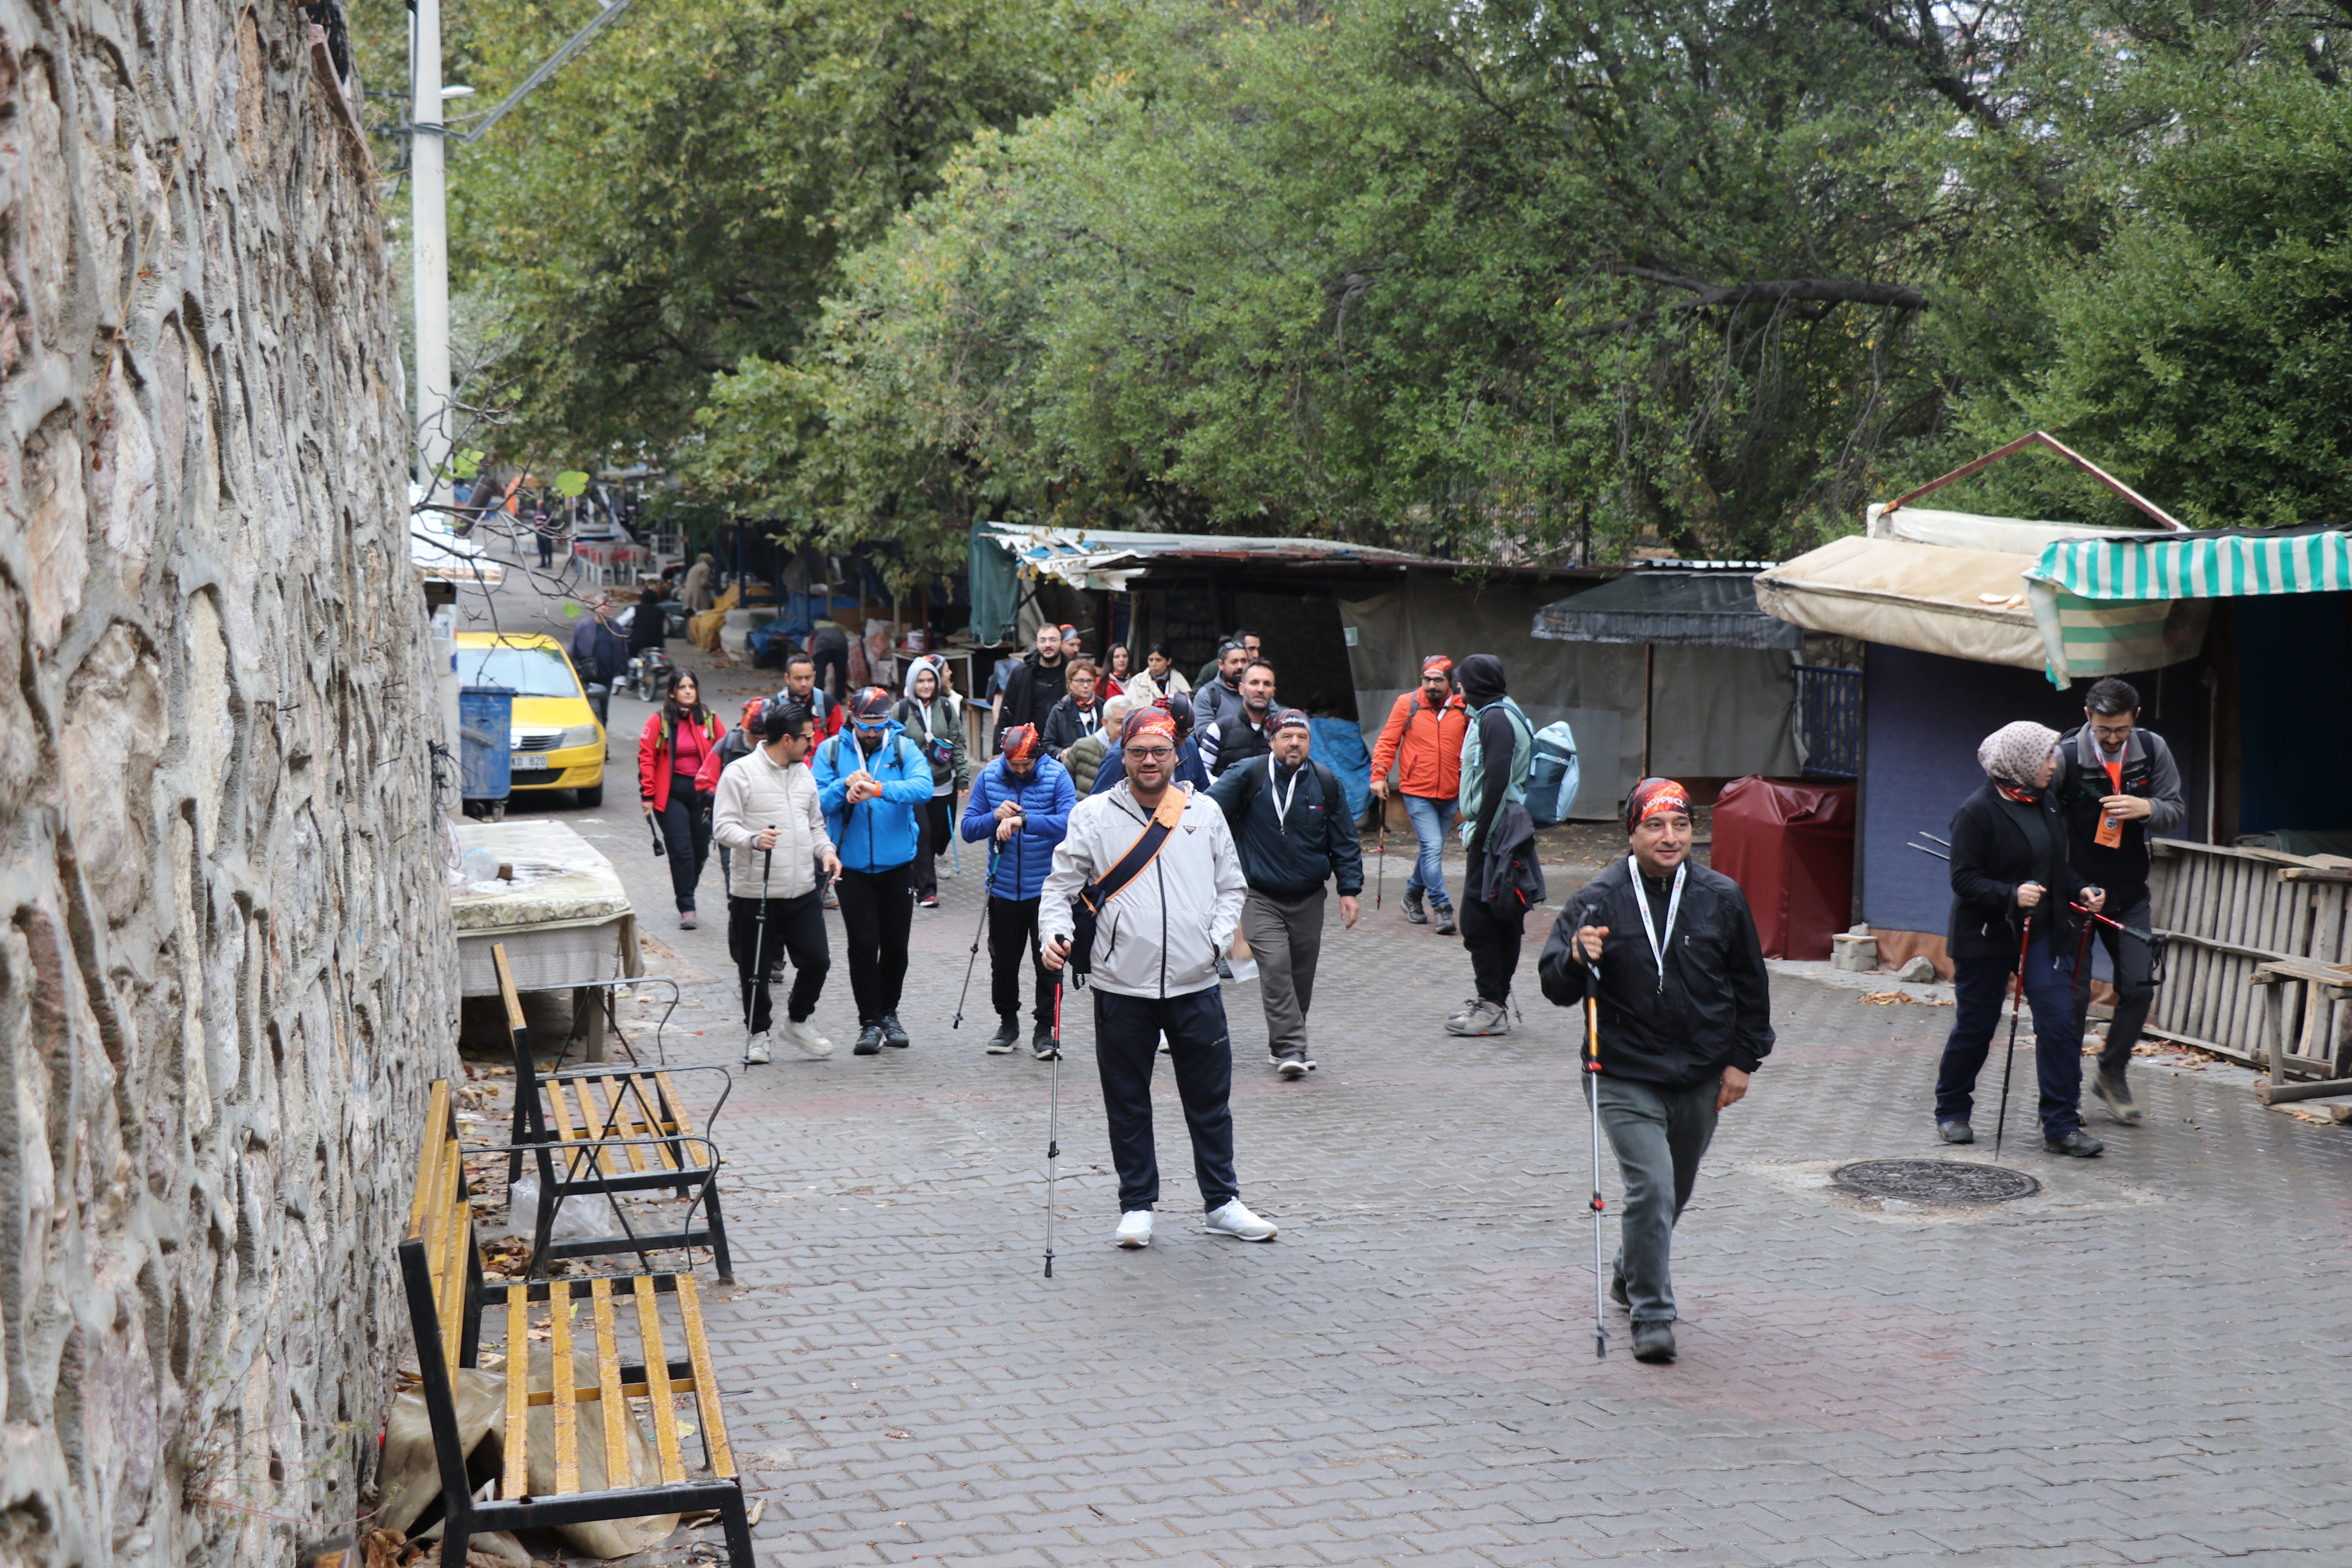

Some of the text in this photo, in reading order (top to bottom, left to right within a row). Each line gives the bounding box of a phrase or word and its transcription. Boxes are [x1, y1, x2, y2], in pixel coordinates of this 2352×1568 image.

[1139, 726, 1174, 742] Dikkan
[529, 756, 546, 766] 820
[1642, 796, 1684, 811] Dikkan
[1632, 869, 1641, 891] Dikkan
[1675, 869, 1684, 889] Dikkan
[1641, 905, 1650, 926] Dikkan
[1668, 904, 1676, 925] Dikkan
